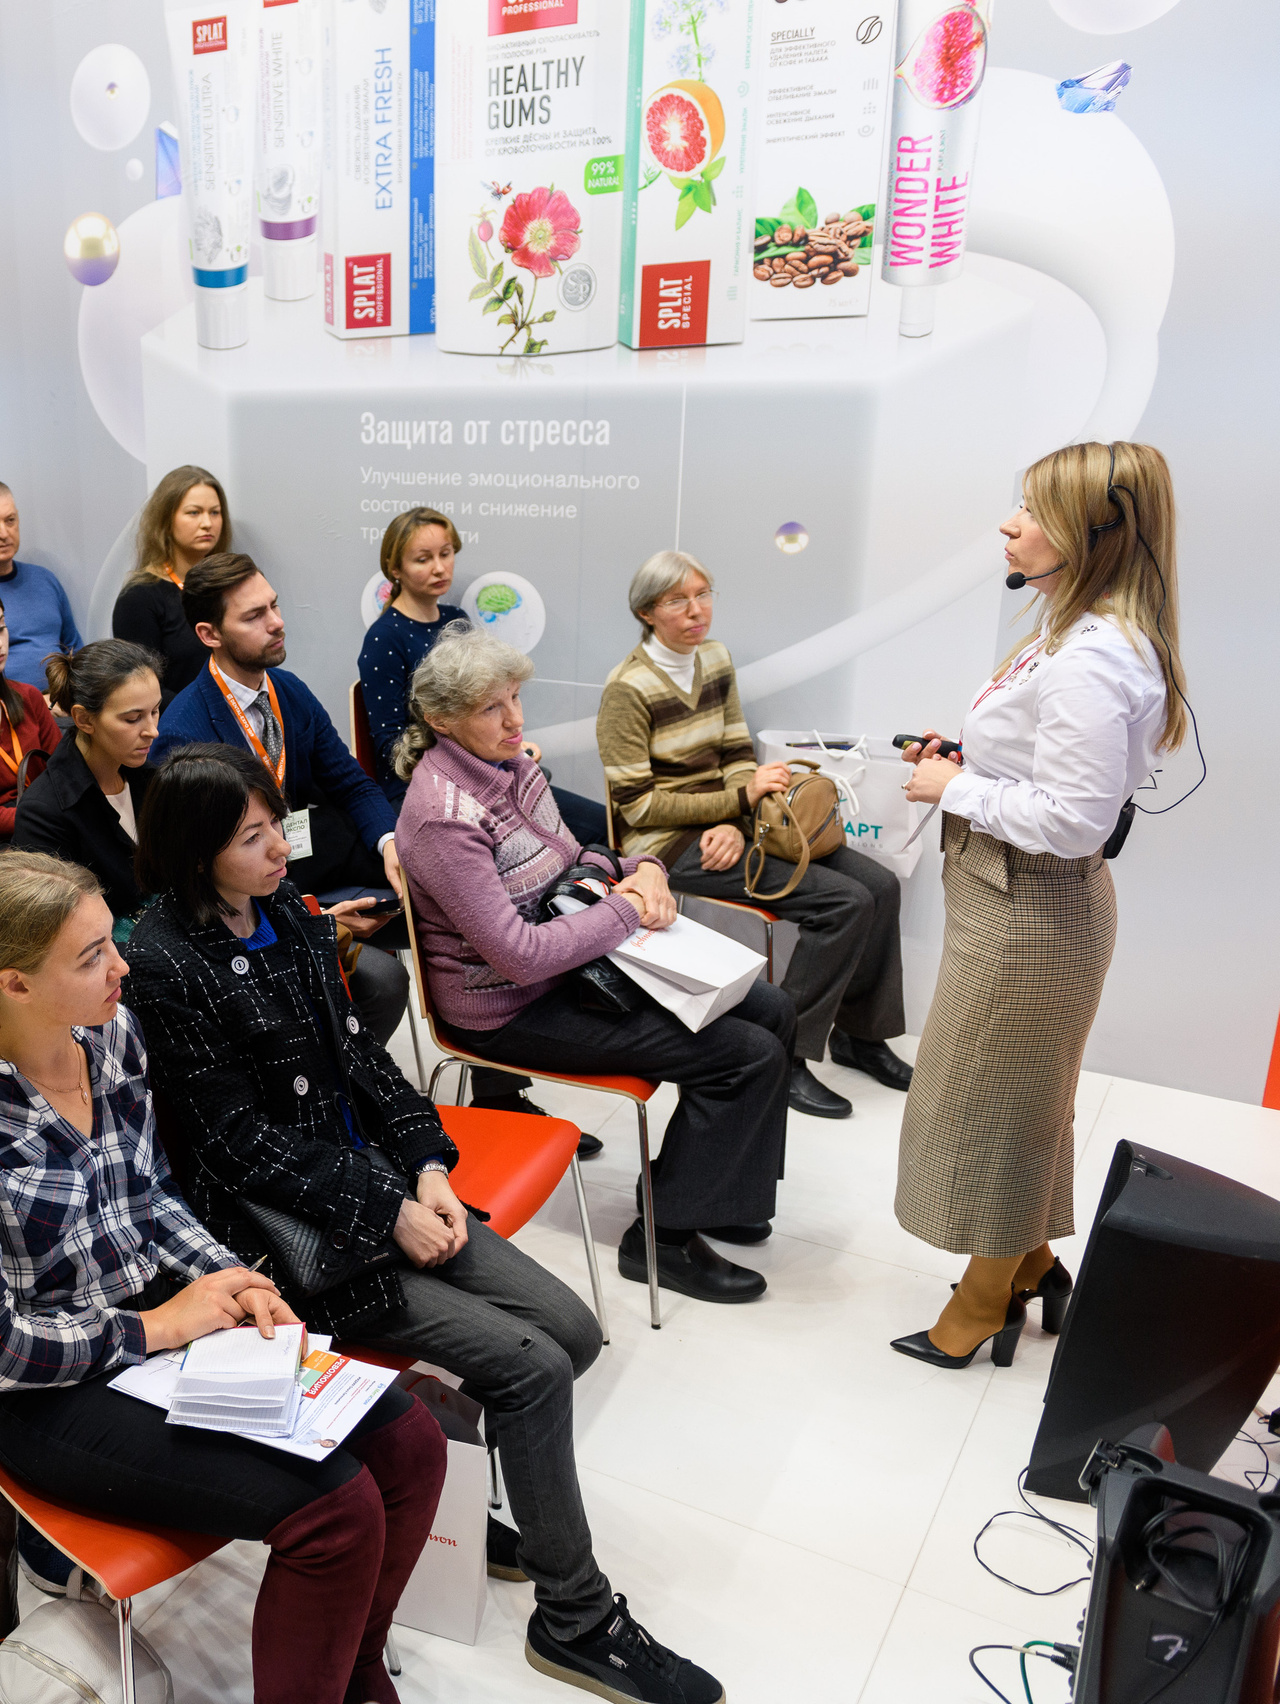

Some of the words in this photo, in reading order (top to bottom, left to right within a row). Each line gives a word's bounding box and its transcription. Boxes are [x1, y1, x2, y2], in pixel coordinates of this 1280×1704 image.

[501, 0, 565, 16] PROFESSIONAL
[196, 22, 224, 43] SPLAT
[271, 31, 283, 77] WHITE
[771, 27, 815, 42] SPECIALLY
[202, 72, 213, 119] ULTRA
[375, 47, 393, 124] FRESH
[488, 55, 585, 97] HEALTHY
[272, 80, 285, 148] SENSITIVE
[488, 95, 551, 130] GUMS
[203, 121, 216, 191] SENSITIVE
[375, 132, 393, 210] EXTRA
[591, 160, 615, 176] 99%
[588, 176, 620, 188] NATURAL
[889, 134, 933, 267] WONDER
[928, 171, 969, 269] WHITE
[353, 263, 375, 319] SPLAT
[375, 257, 385, 323] PROFESSIONAL
[658, 277, 683, 330] SPLAT
[681, 275, 693, 329] SPECIAL
[360, 411, 453, 450] Защита
[464, 419, 490, 445] от
[500, 418, 611, 452] стресса
[360, 466, 462, 489] Улучшение
[468, 470, 640, 490] эмоционального
[461, 501, 472, 515] и
[479, 501, 578, 519] снижение
[308, 1358, 345, 1395] РЕВОЛЮЦИЯ
